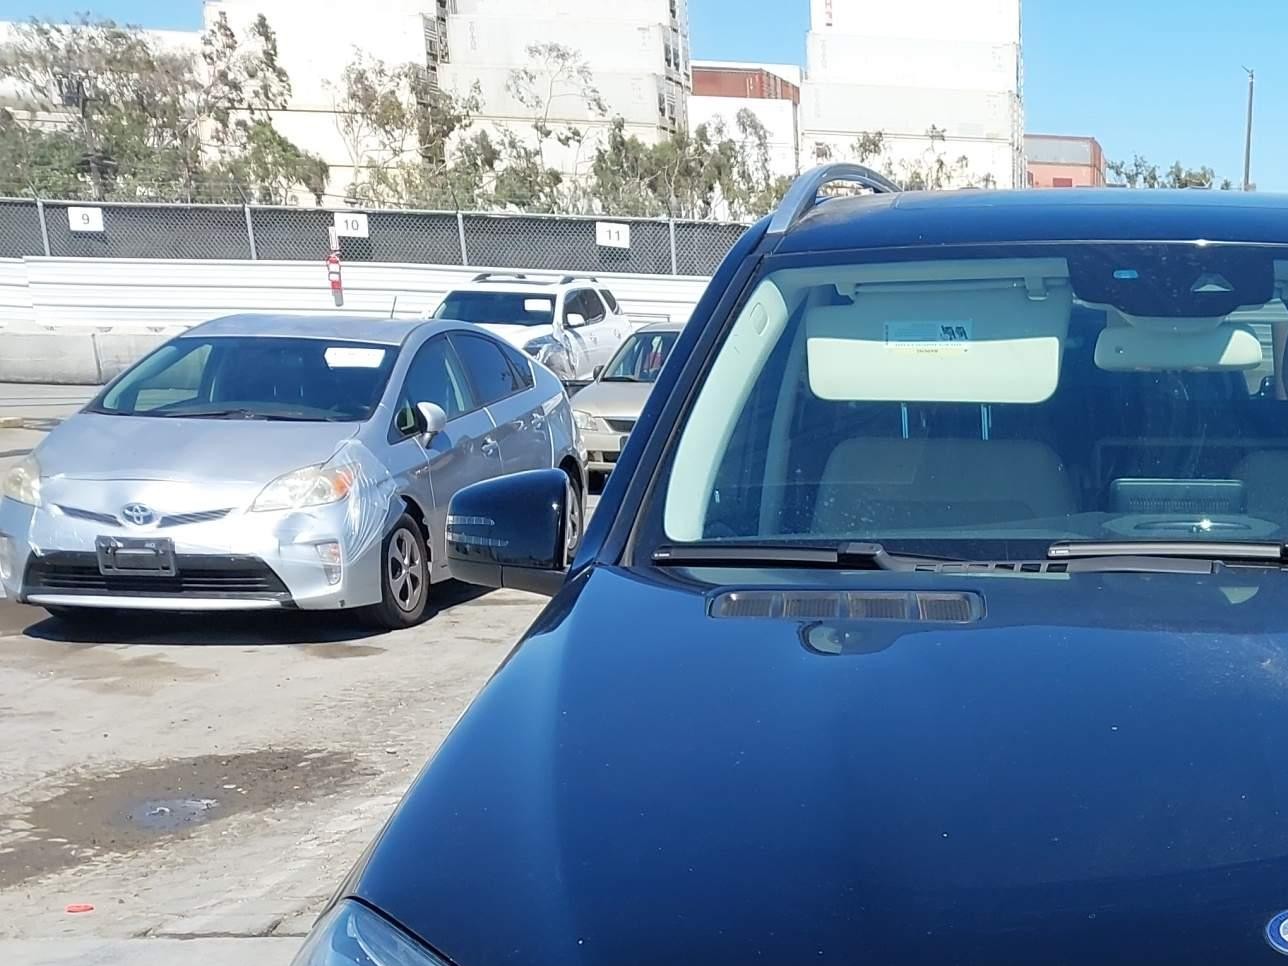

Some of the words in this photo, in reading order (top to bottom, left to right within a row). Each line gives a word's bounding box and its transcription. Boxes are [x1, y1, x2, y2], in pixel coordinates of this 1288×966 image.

[81, 213, 90, 225] 9
[344, 219, 359, 231] 10
[607, 229, 621, 241] 11
